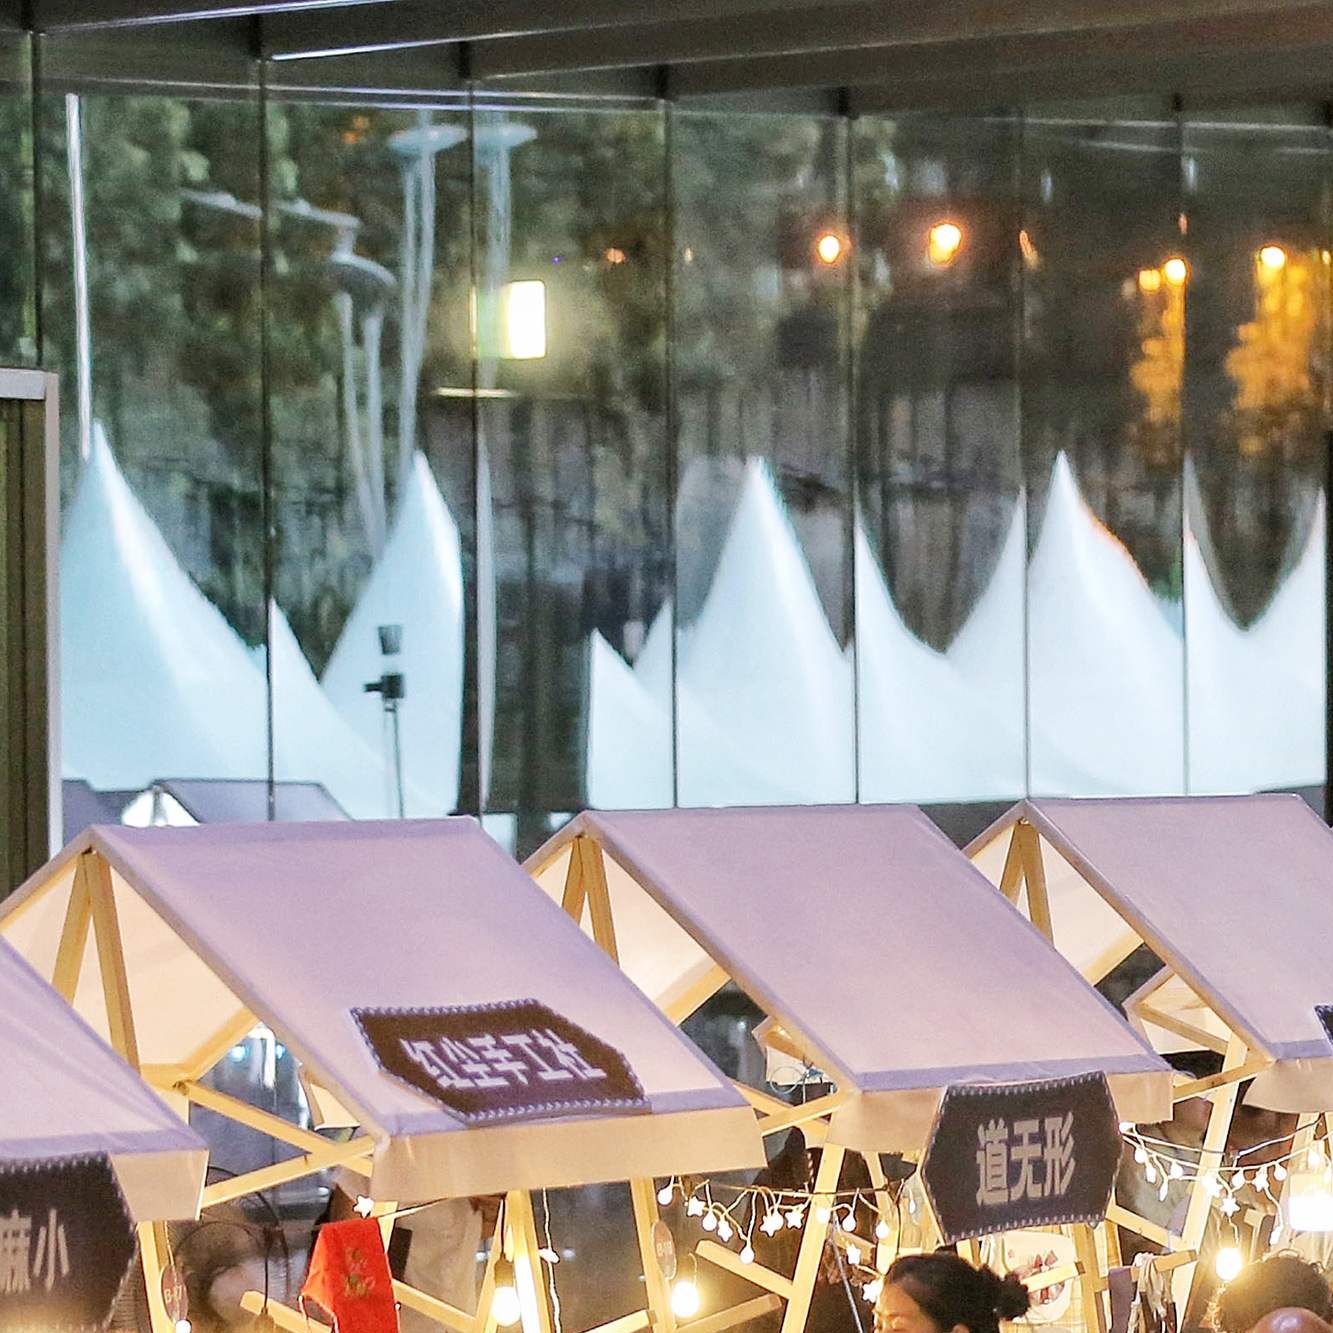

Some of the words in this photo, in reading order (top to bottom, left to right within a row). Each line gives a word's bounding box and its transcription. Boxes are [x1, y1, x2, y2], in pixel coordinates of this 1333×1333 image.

[400, 1028, 607, 1089] 红尘手工社
[976, 1111, 1077, 1207] 道无形
